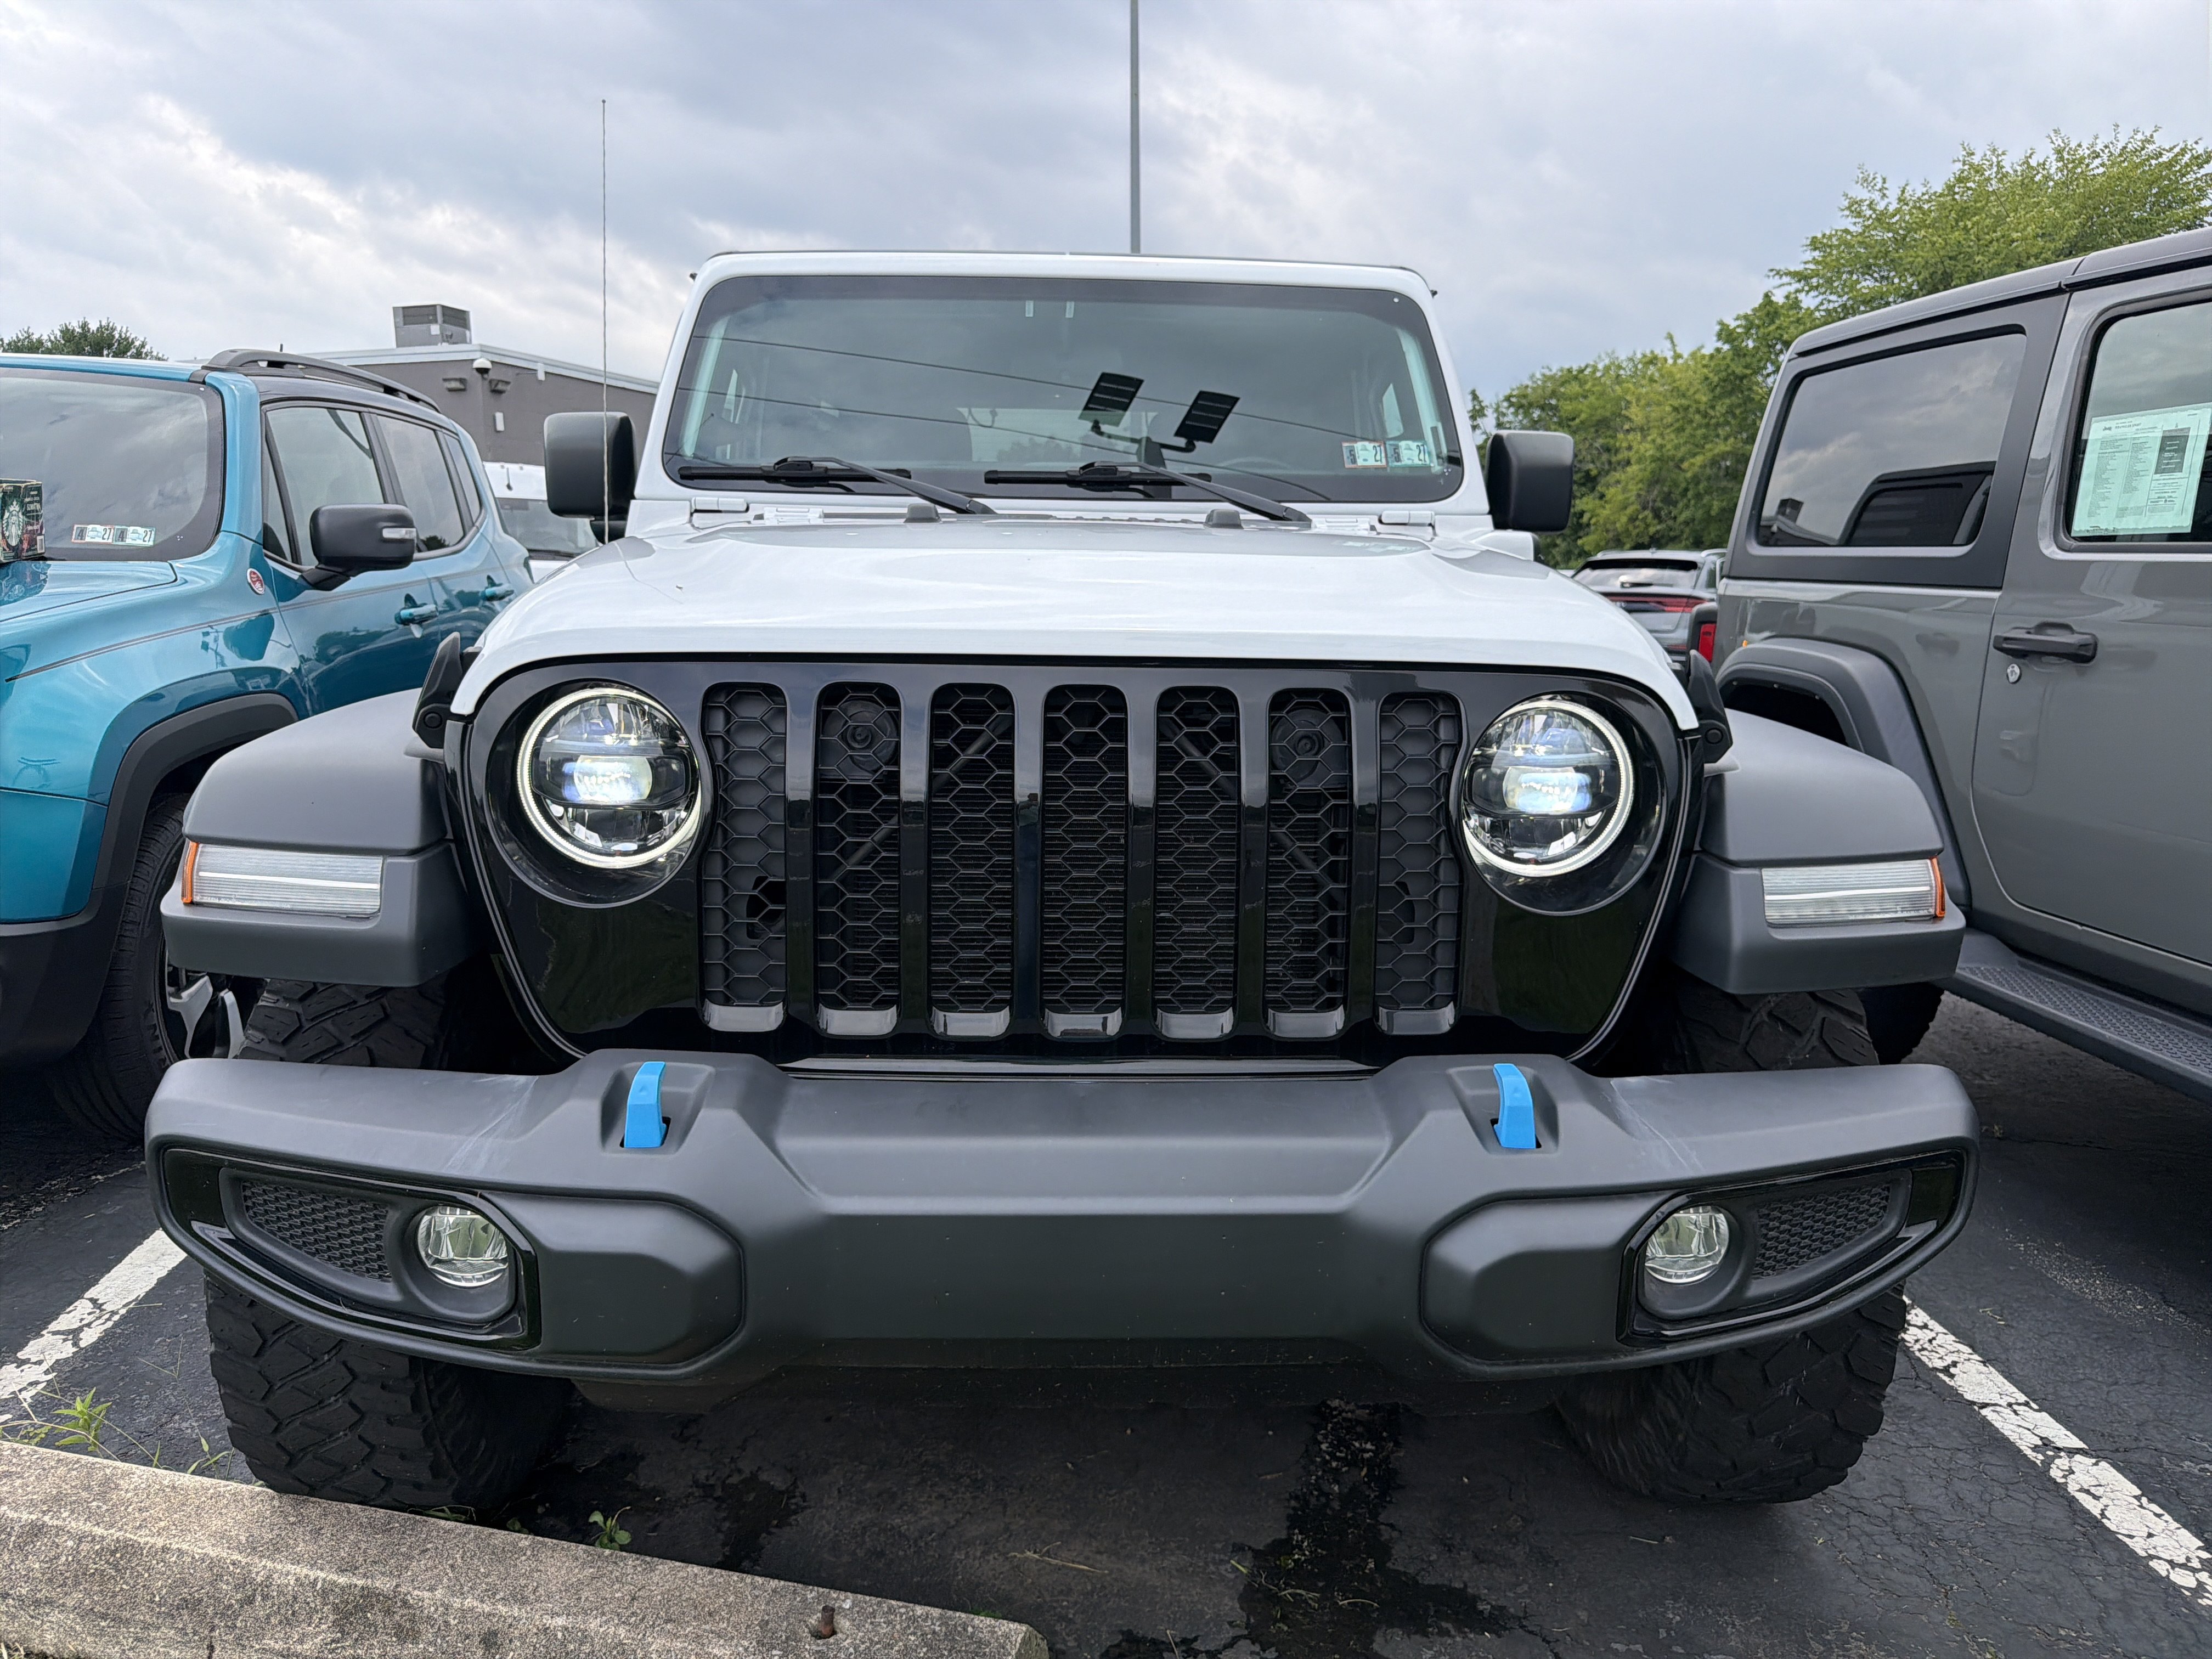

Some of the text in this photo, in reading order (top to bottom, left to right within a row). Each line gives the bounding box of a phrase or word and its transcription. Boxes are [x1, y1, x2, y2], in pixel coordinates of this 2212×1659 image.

[1349, 445, 1383, 465] 5 27
[1393, 444, 1427, 464] 5 27
[77, 528, 112, 541] 4 27
[118, 529, 153, 543] 4 27
